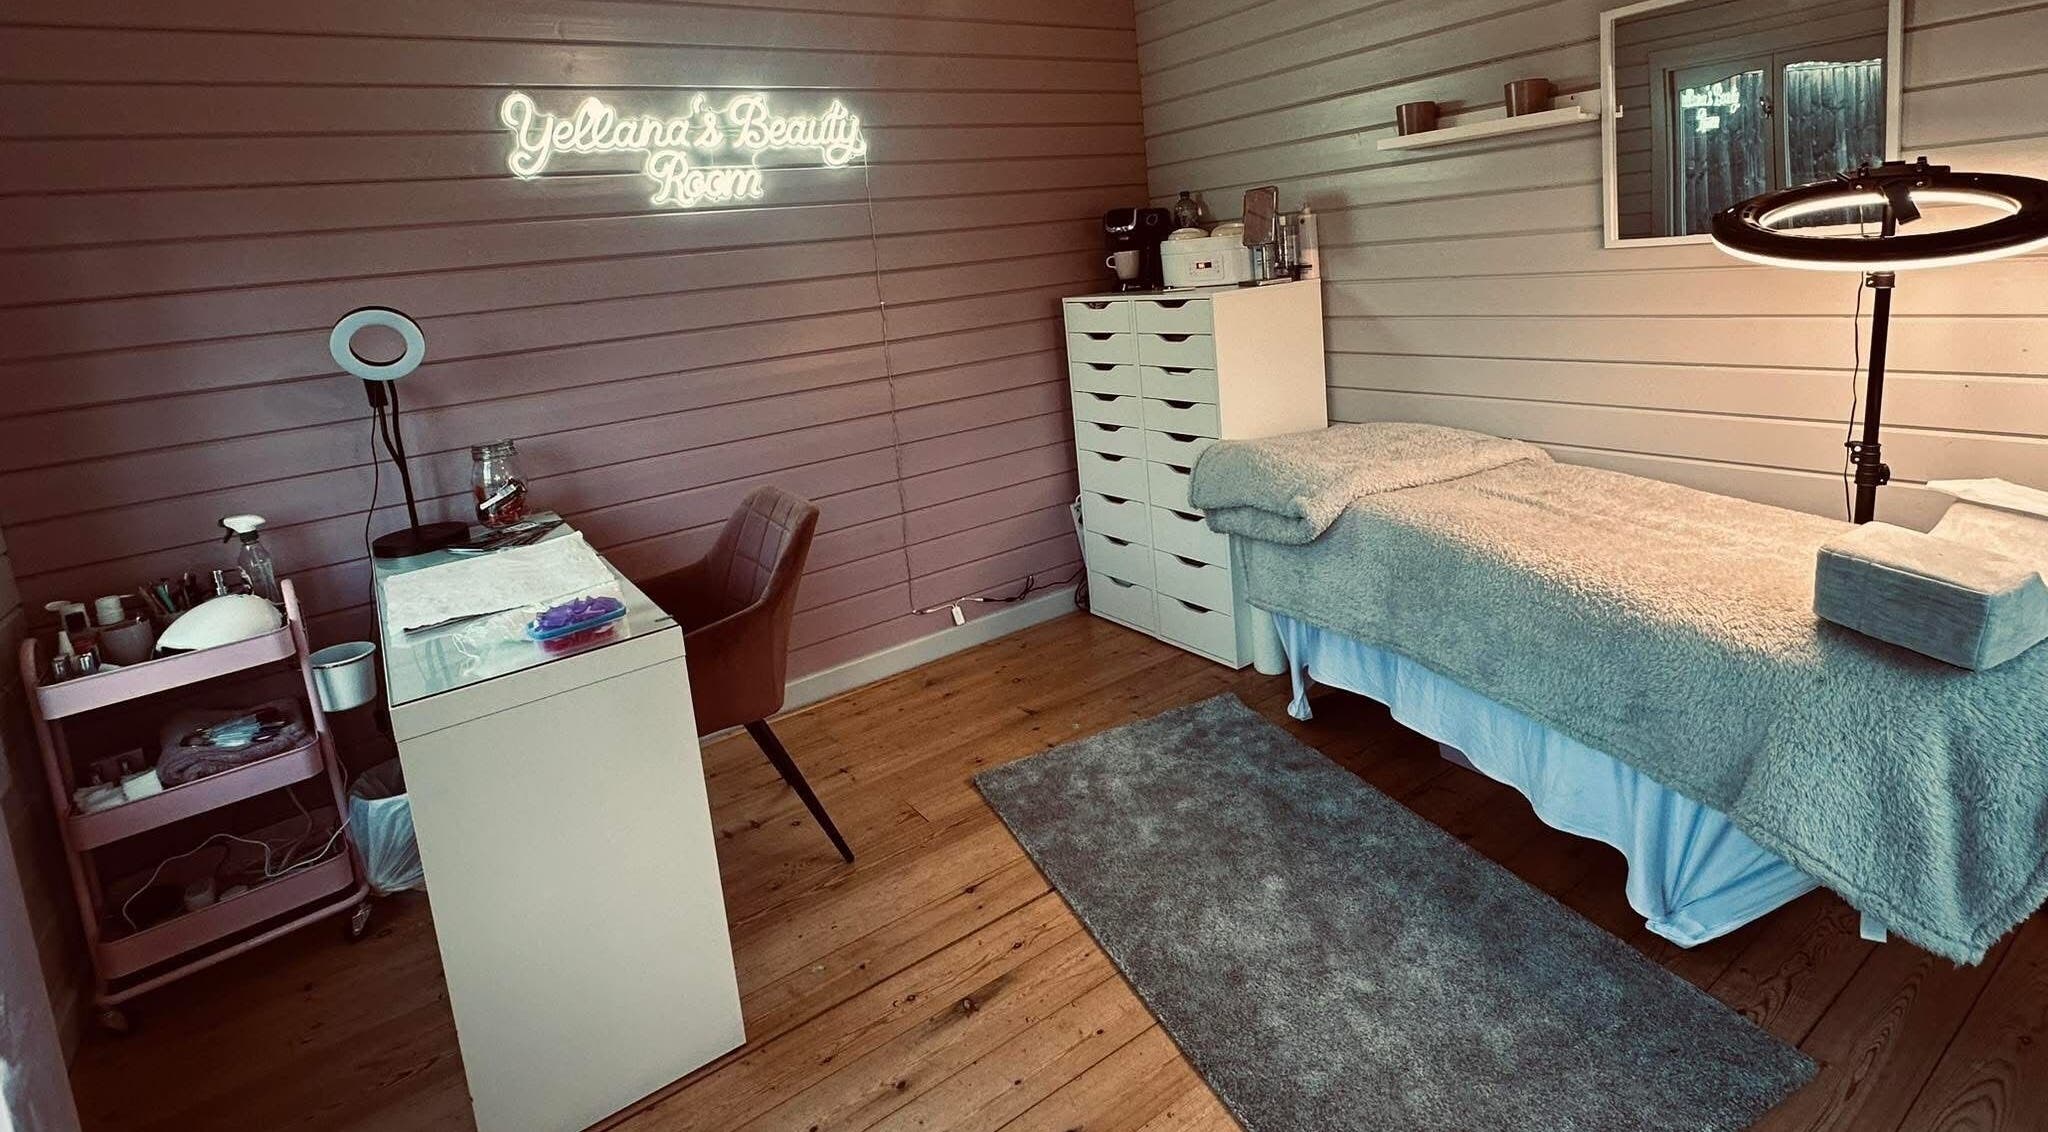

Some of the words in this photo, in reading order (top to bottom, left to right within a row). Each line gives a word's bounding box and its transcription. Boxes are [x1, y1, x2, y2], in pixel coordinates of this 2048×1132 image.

[501, 93, 723, 173] Yellana's
[728, 96, 866, 166] Beauty
[650, 150, 763, 206] Room
